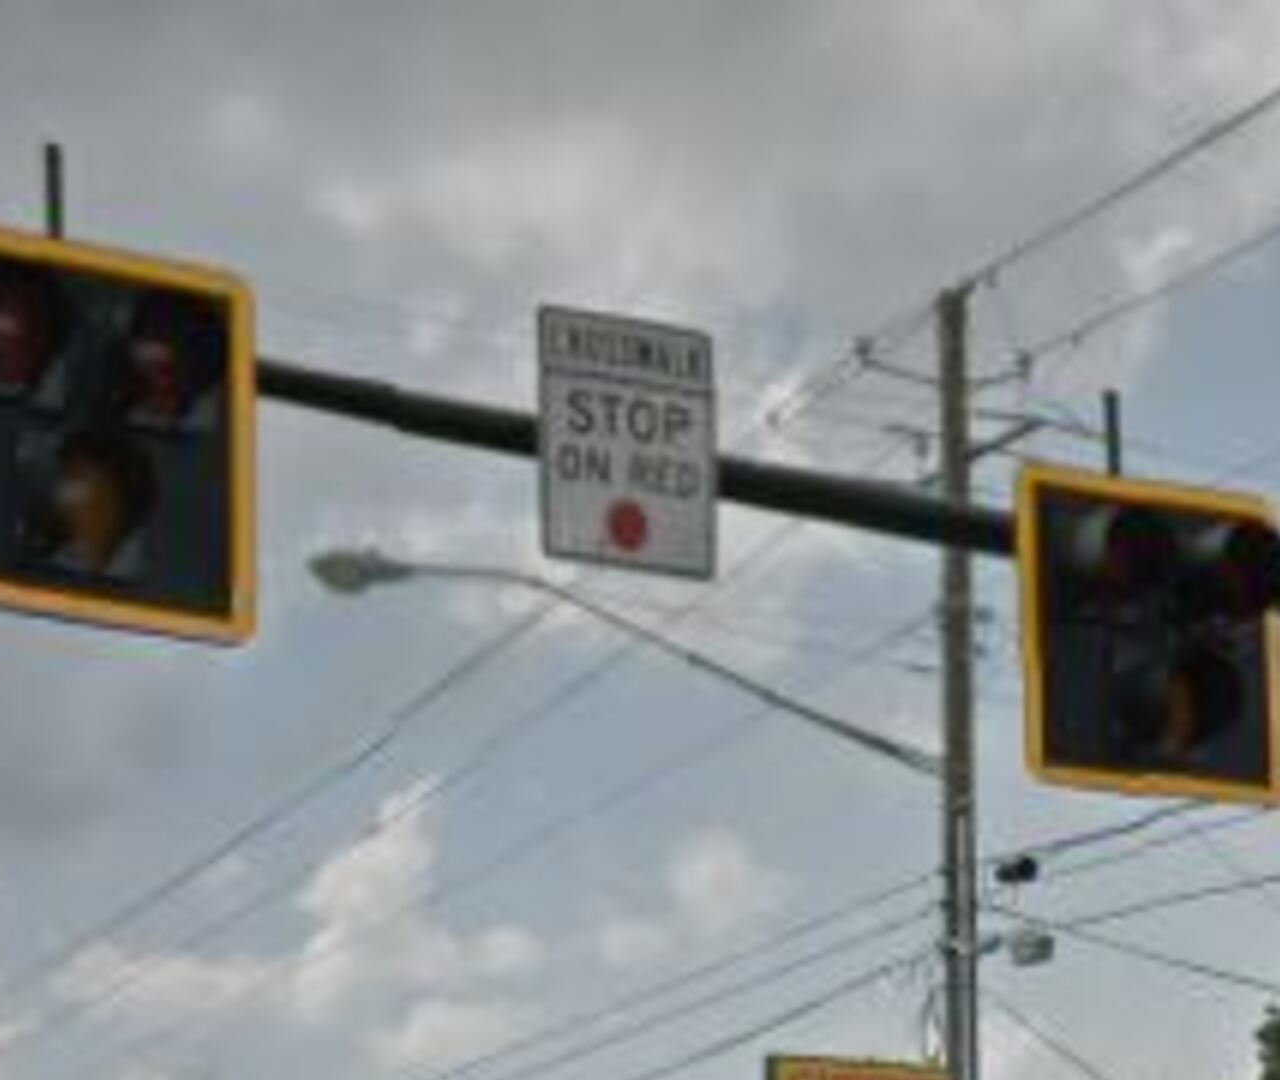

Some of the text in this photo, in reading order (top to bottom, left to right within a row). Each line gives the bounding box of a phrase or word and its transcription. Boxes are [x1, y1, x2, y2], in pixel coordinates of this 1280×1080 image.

[566, 388, 691, 446] STOP
[557, 442, 702, 499] ON RED
